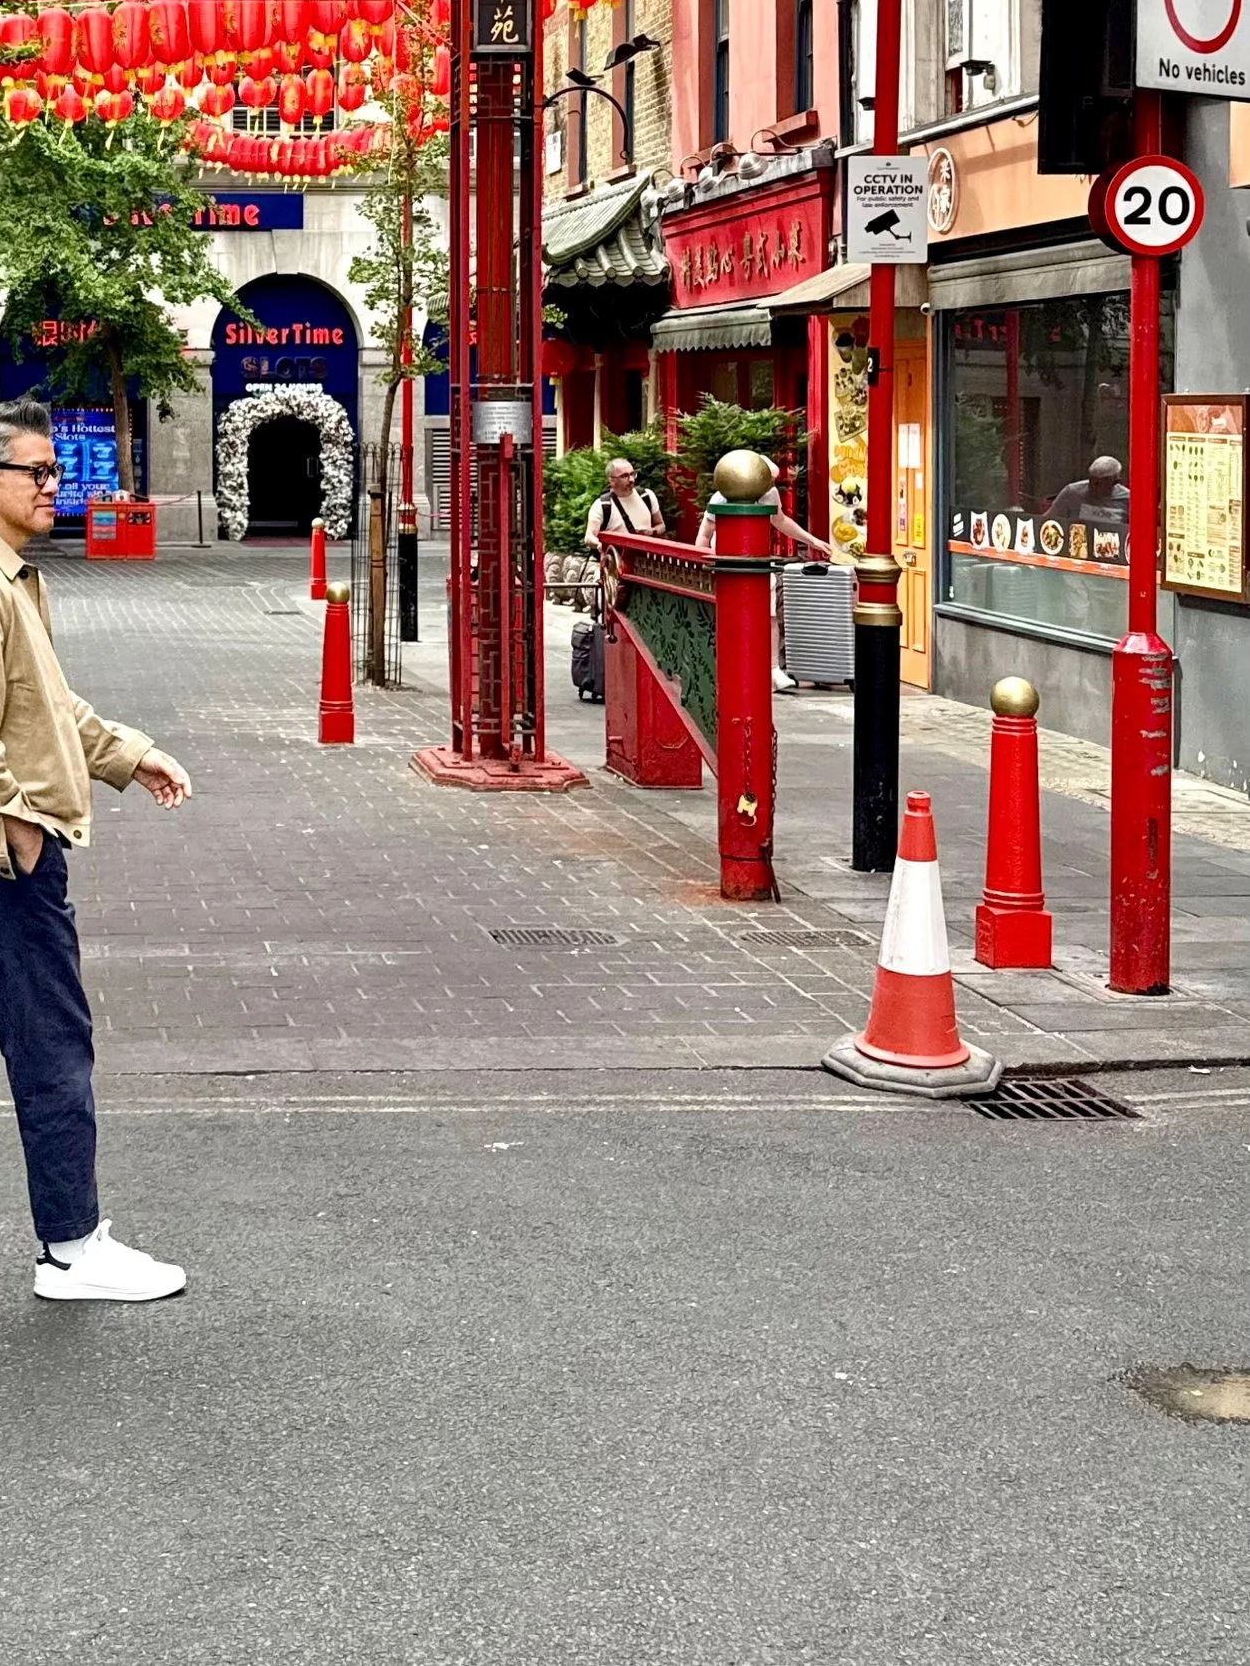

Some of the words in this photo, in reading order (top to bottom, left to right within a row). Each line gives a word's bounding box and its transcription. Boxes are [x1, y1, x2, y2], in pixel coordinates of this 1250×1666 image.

[1158, 57, 1180, 79] No
[1185, 62, 1246, 86] vehicles
[863, 174, 897, 184] CCTV
[900, 174, 913, 184] IN
[853, 185, 923, 195] OPERATION
[888, 195, 906, 203] safety
[1123, 186, 1190, 226] 20
[225, 321, 344, 345] SilverTime
[245, 383, 273, 392] OPEN
[72, 424, 116, 433] Hottest
